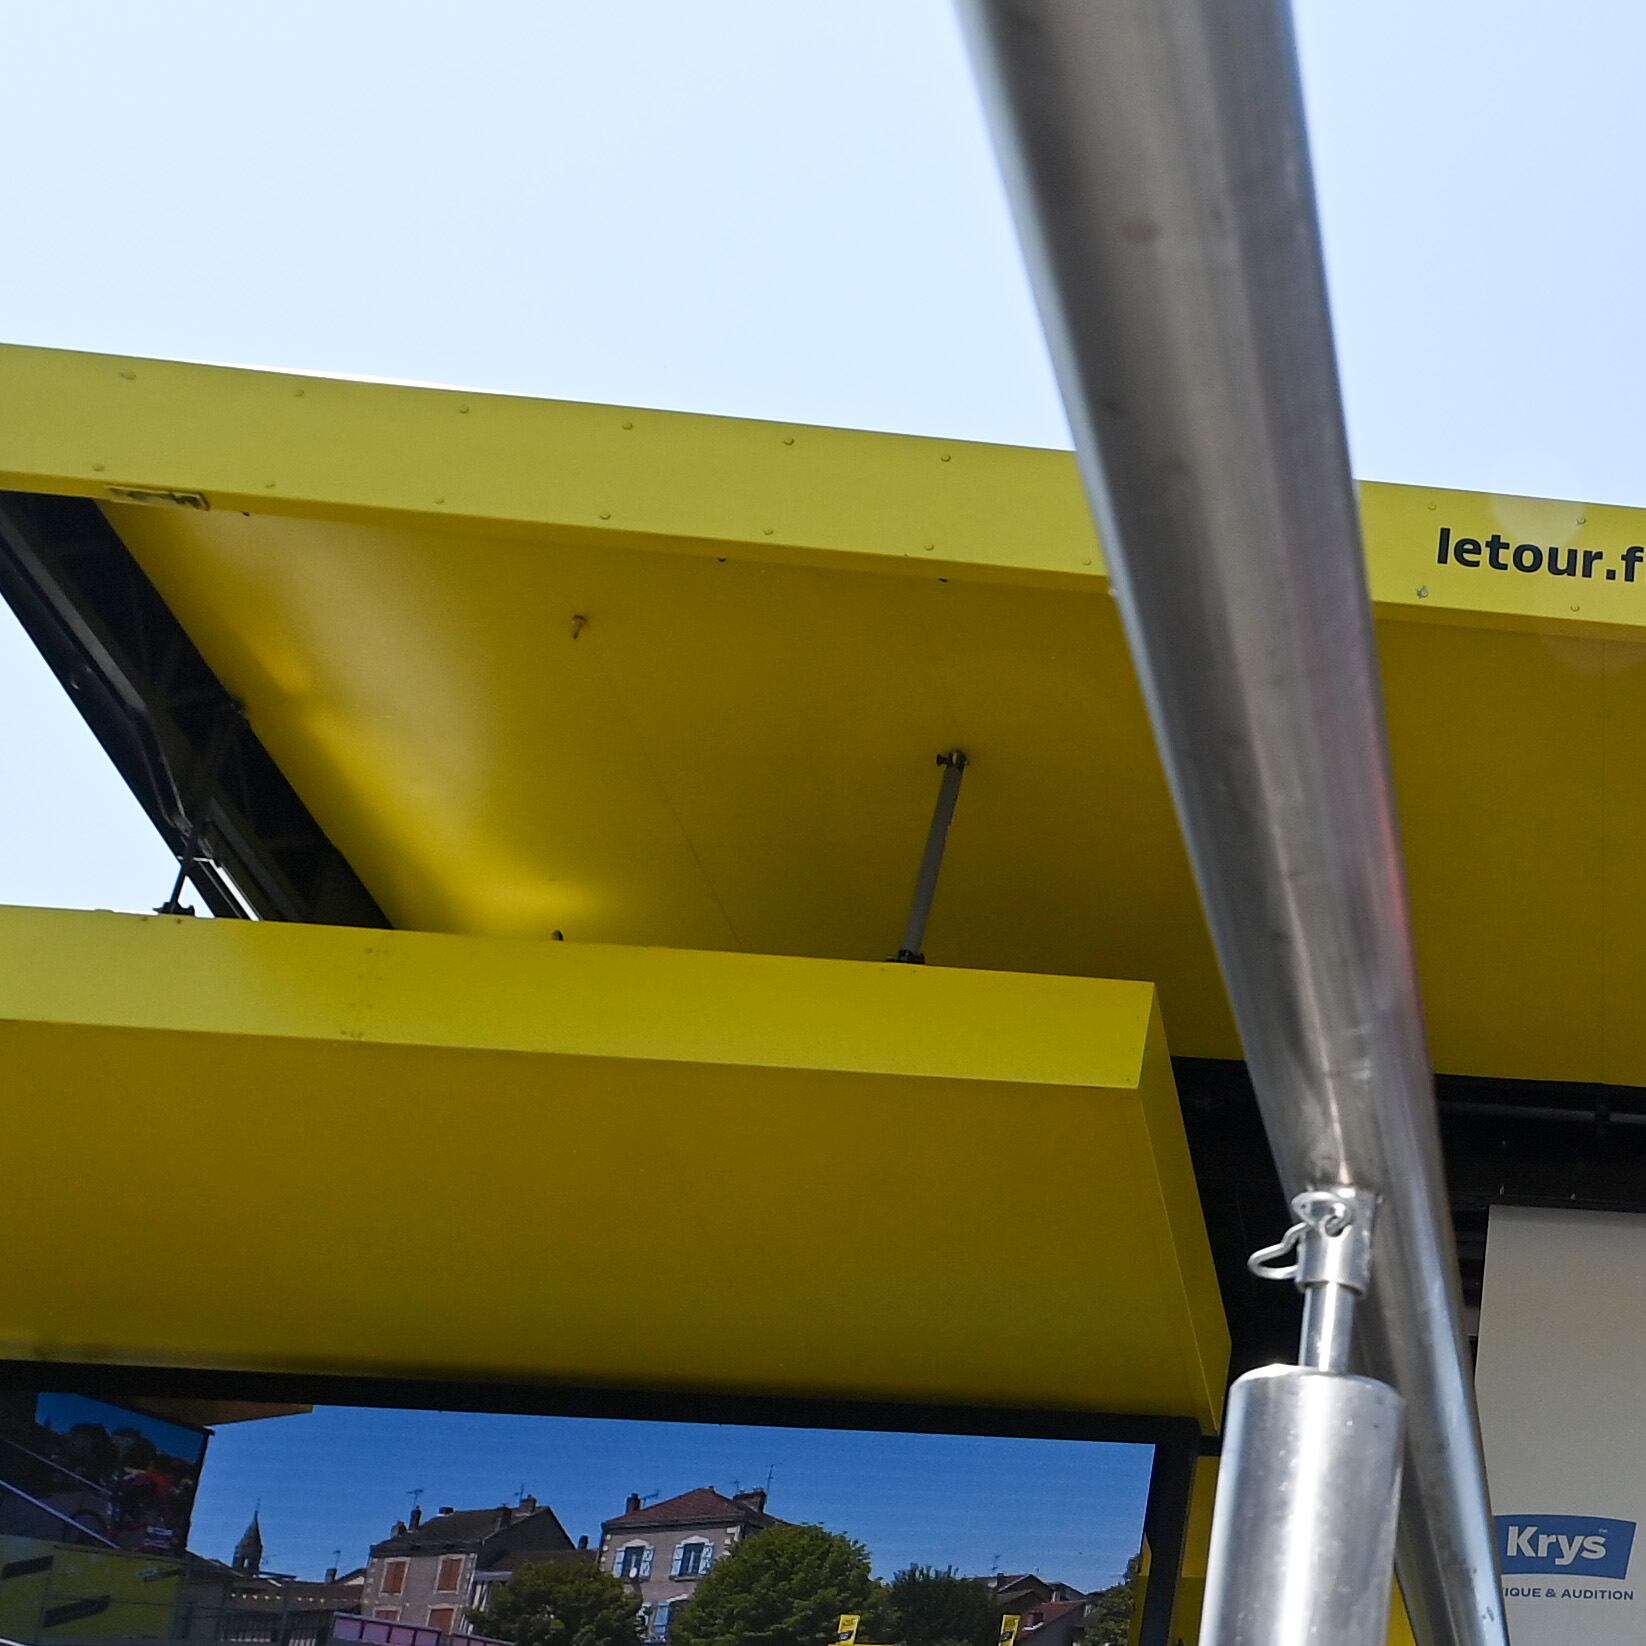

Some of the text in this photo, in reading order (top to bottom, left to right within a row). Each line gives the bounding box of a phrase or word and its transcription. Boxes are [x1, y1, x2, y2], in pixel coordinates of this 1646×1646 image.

[1506, 1525, 1607, 1566] Krys
[1502, 1587, 1542, 1599] IQUE
[1561, 1587, 1635, 1601] AUDITION
